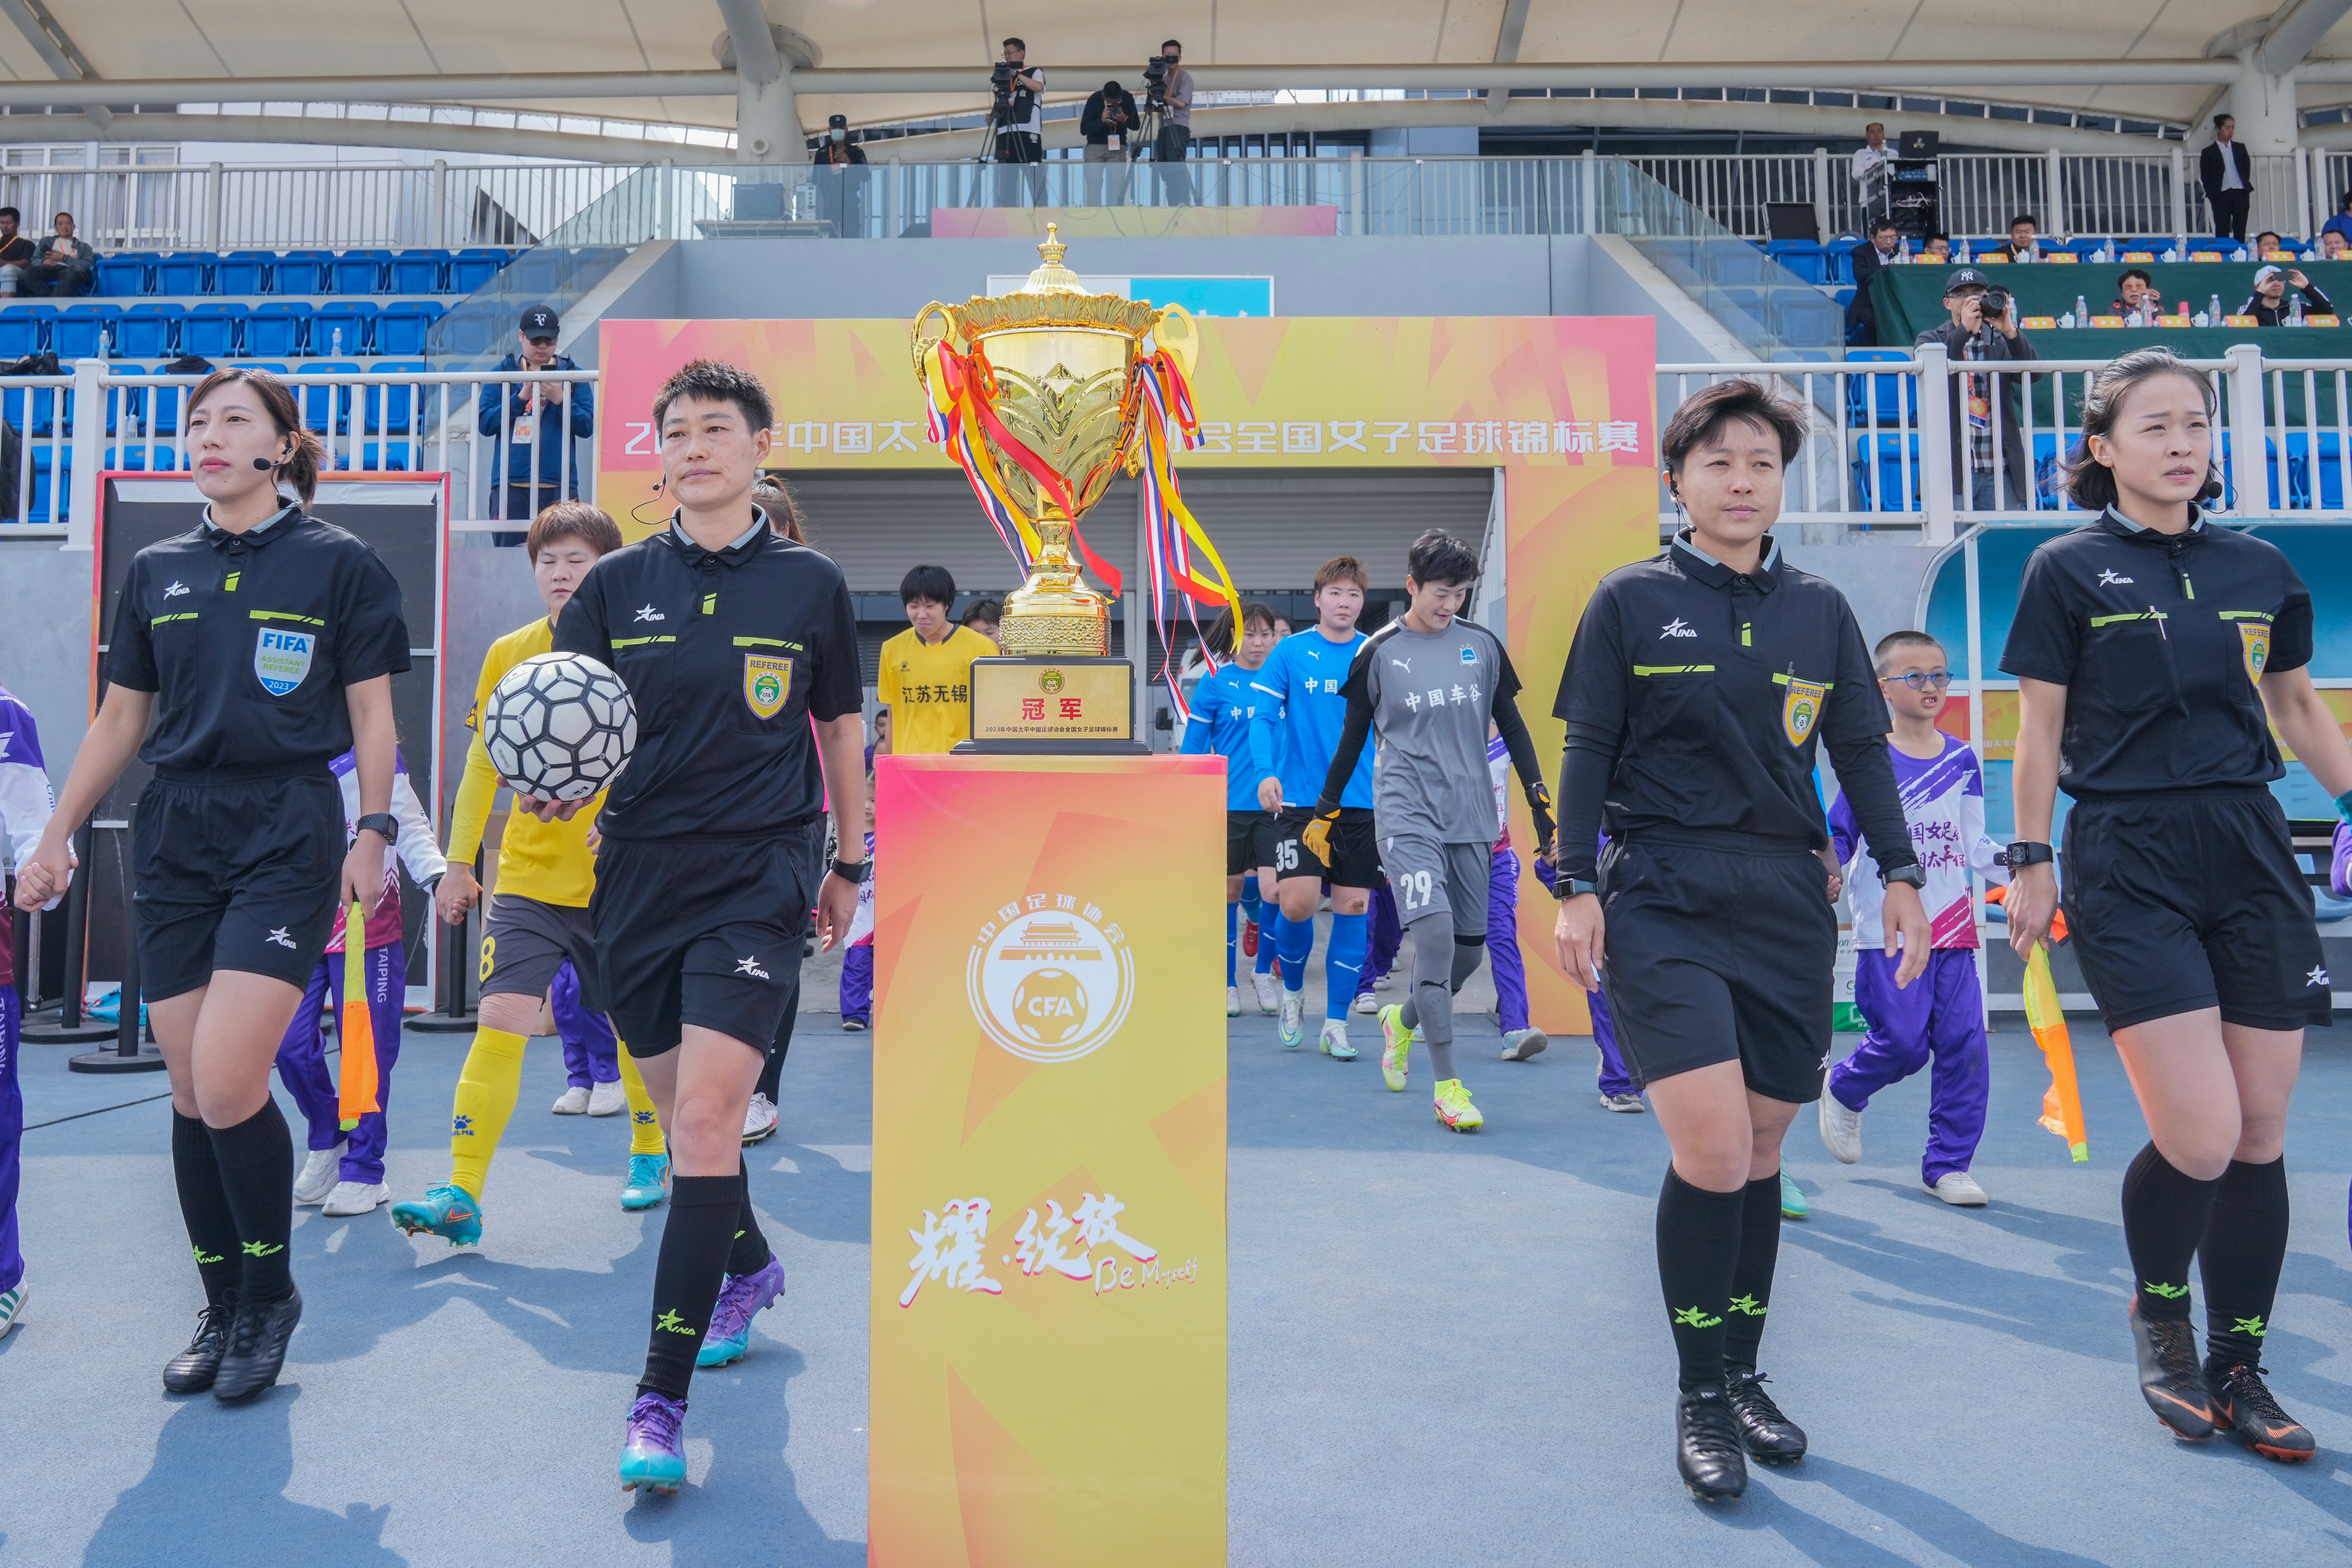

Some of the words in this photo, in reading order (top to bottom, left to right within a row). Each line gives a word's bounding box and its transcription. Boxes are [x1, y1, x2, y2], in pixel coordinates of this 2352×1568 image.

[260, 655, 305, 667] ASSISTANT
[263, 664, 300, 674] REFEREE
[750, 660, 789, 671] REFEREE
[268, 680, 289, 690] 2023
[902, 685, 967, 703] 江苏无锡
[1792, 685, 1823, 698] REFEREE
[1404, 683, 1482, 713] 中国车谷
[1022, 698, 1082, 720] 冠军
[1276, 839, 1299, 872] 35
[1400, 870, 1432, 910] 29
[978, 893, 1125, 945] 中国足球协会
[377, 945, 388, 1003] TAIPING
[1028, 996, 1075, 1016] CFA
[1095, 1256, 1135, 1297] Be
[1140, 1257, 1200, 1290] Myself
